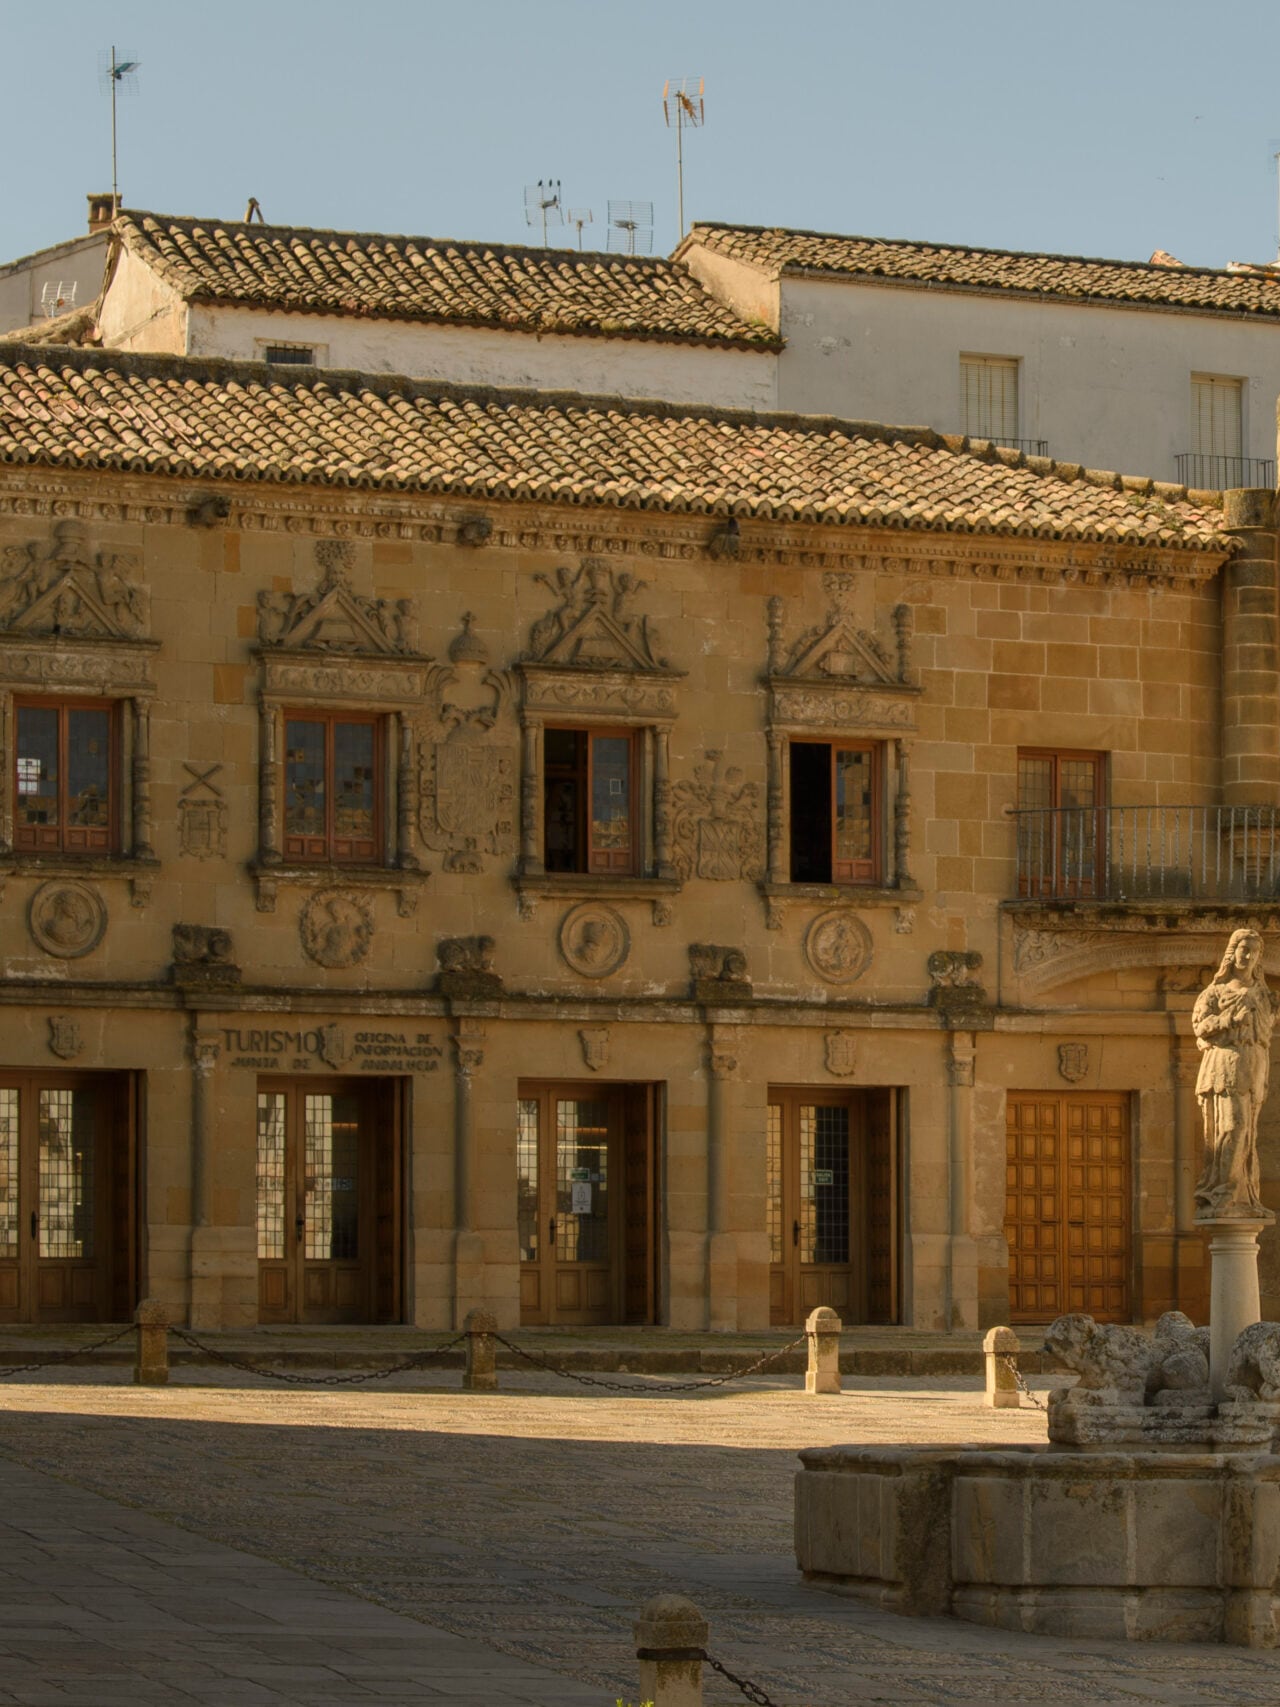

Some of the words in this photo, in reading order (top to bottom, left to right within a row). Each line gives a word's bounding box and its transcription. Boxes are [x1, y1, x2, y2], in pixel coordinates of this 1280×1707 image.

[219, 1028, 318, 1054] TURISMO
[354, 1032, 407, 1044] OFICINA
[416, 1033, 433, 1044] DE
[231, 1057, 279, 1069] JUNTA
[293, 1058, 312, 1070] DE
